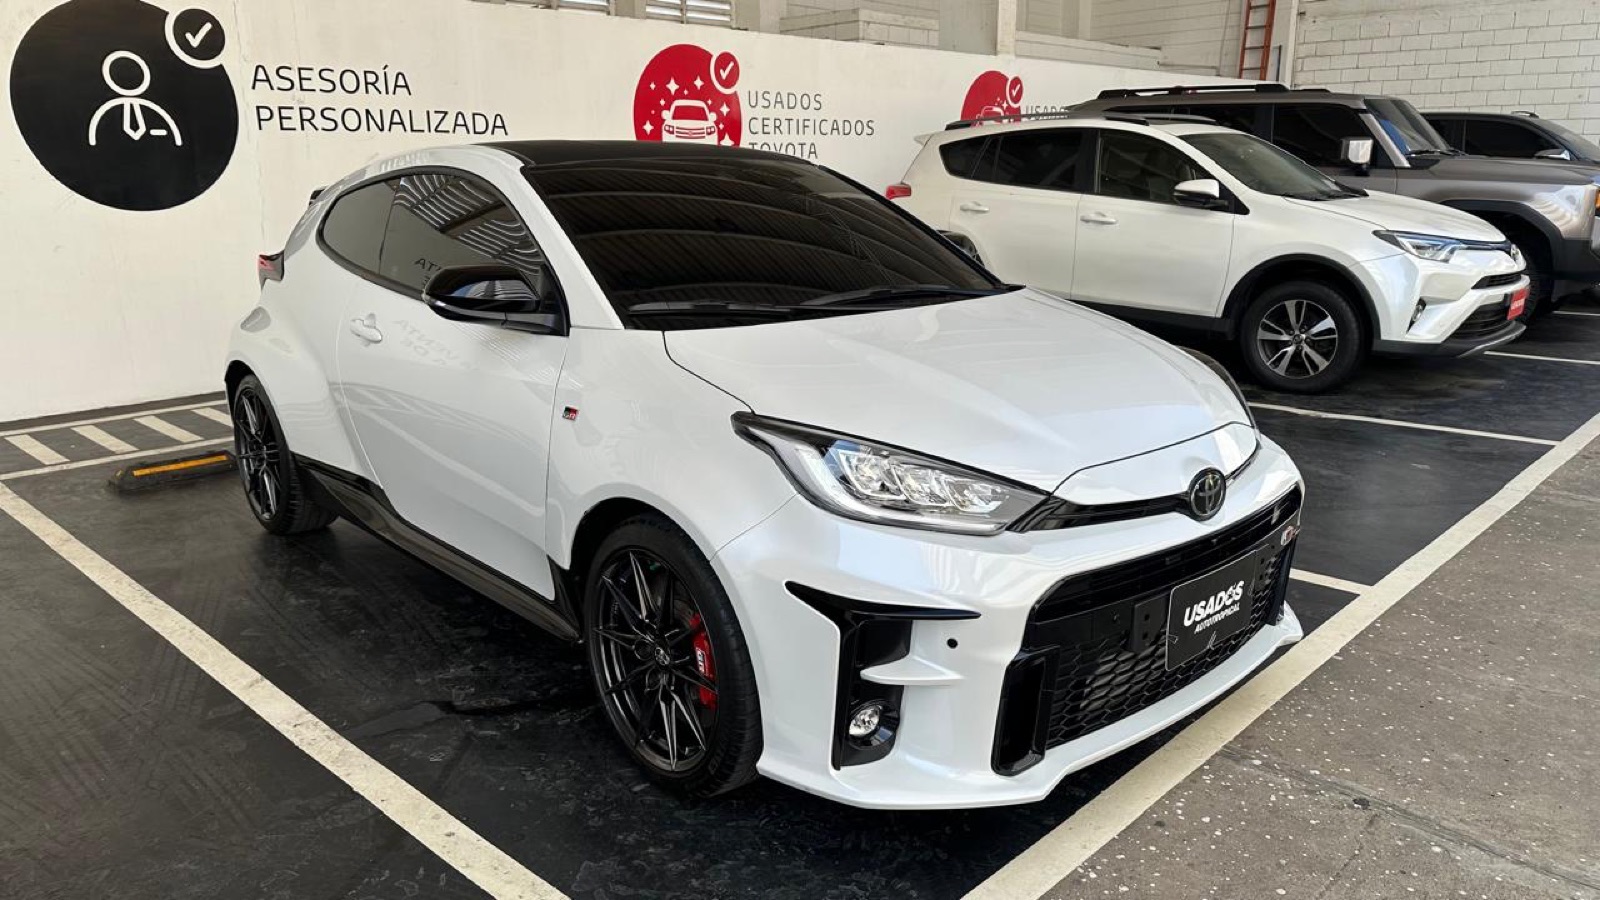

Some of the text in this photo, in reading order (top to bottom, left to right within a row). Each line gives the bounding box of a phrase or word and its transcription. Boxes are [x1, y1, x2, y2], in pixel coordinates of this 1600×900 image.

[251, 64, 412, 96] ASESORÍA
[748, 90, 822, 111] USADOS
[255, 105, 509, 136] PERSONALIZADA
[748, 116, 875, 136] CERTIFICADOS
[1183, 580, 1245, 627] USADOS
